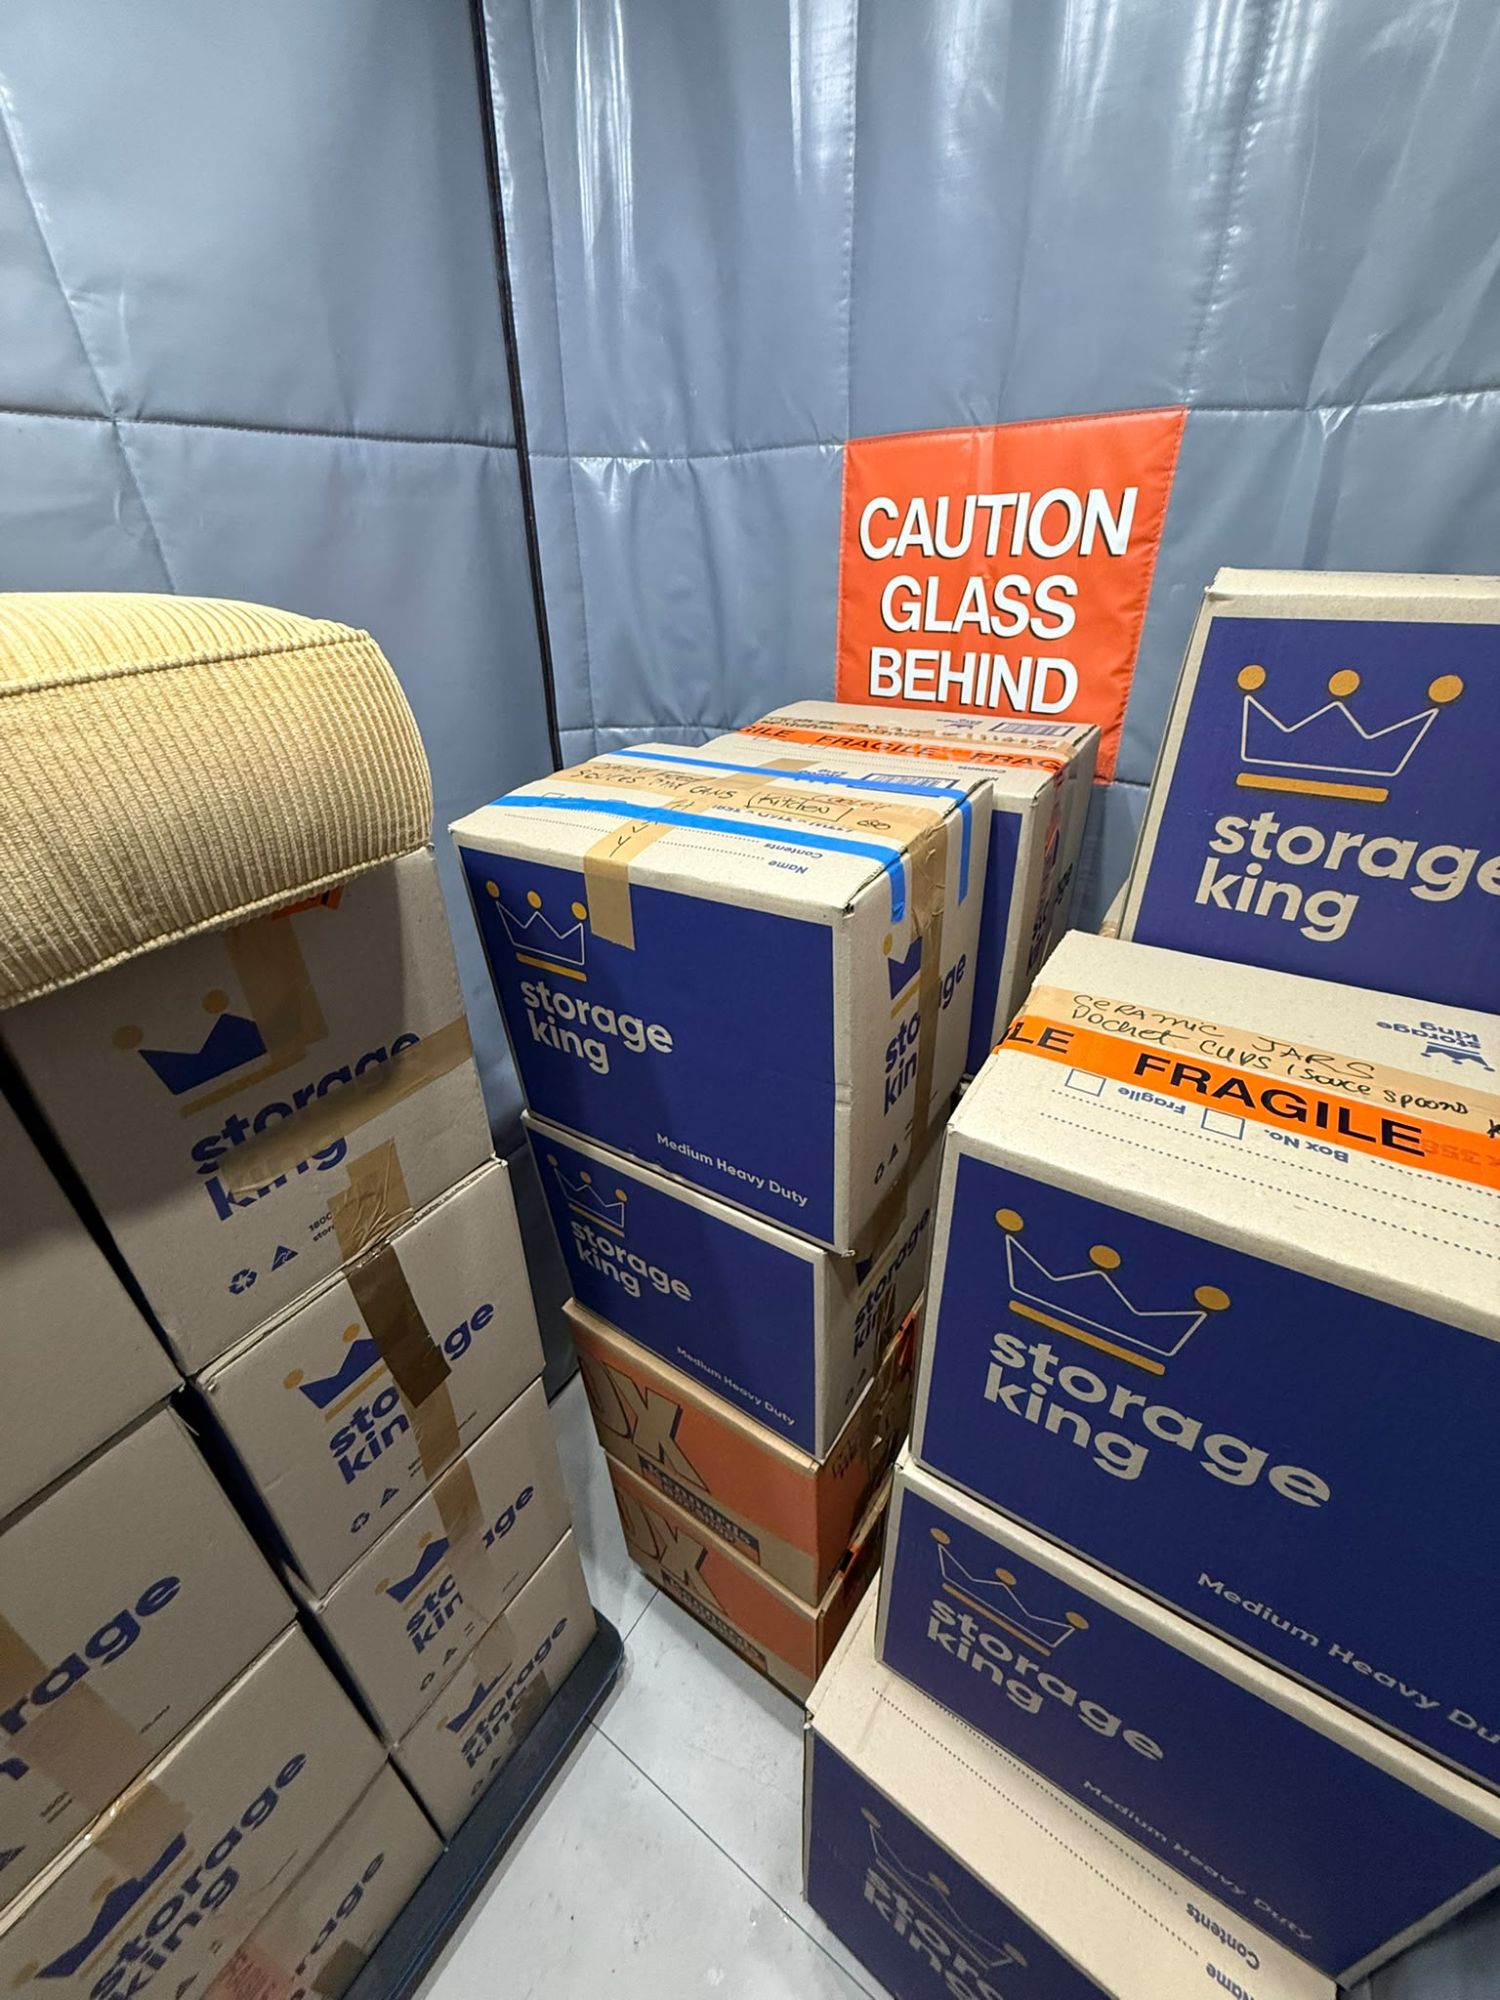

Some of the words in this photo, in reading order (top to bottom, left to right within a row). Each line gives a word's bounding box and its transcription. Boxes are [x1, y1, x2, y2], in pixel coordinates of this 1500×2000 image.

[859, 486, 1139, 560] CAUTION
[881, 574, 1079, 640] GLASS
[868, 646, 1080, 715] BEHIND
[816, 735, 938, 756] FRAGILE
[763, 842, 824, 860] Contents
[767, 859, 809, 875] Name
[1194, 857, 1360, 942] king
[519, 980, 674, 1054] storage
[527, 1009, 612, 1076] king
[1376, 1021, 1482, 1049] storage
[1419, 1022, 1480, 1043] king
[1118, 1087, 1187, 1115] Fragile
[1134, 1053, 1425, 1157] FRAGILE
[656, 1132, 714, 1168] Medium
[716, 1158, 765, 1192] Heavy
[768, 1180, 808, 1208] Duty
[1264, 1129, 1301, 1149] No.
[1305, 1141, 1350, 1163] Box
[571, 1220, 692, 1301] storage
[575, 1238, 641, 1298] king
[676, 1346, 722, 1381] Medium
[722, 1372, 762, 1407] Heavy
[763, 1399, 796, 1427] Duty
[983, 1363, 1149, 1481] king
[989, 1332, 1331, 1508] storage
[336, 1413, 411, 1486] kin
[926, 1615, 1045, 1714] king
[1197, 1572, 1320, 1648] Medium
[1327, 1642, 1441, 1709] Heavy
[461, 1617, 568, 1753] storage
[930, 1599, 1164, 1761] storage
[89, 1752, 307, 2000] storage
[1083, 1780, 1167, 1843] Medium
[1173, 1842, 1247, 1896] Heavy
[1253, 1897, 1312, 1940] Duty
[1186, 1902, 1260, 1971] Contents
